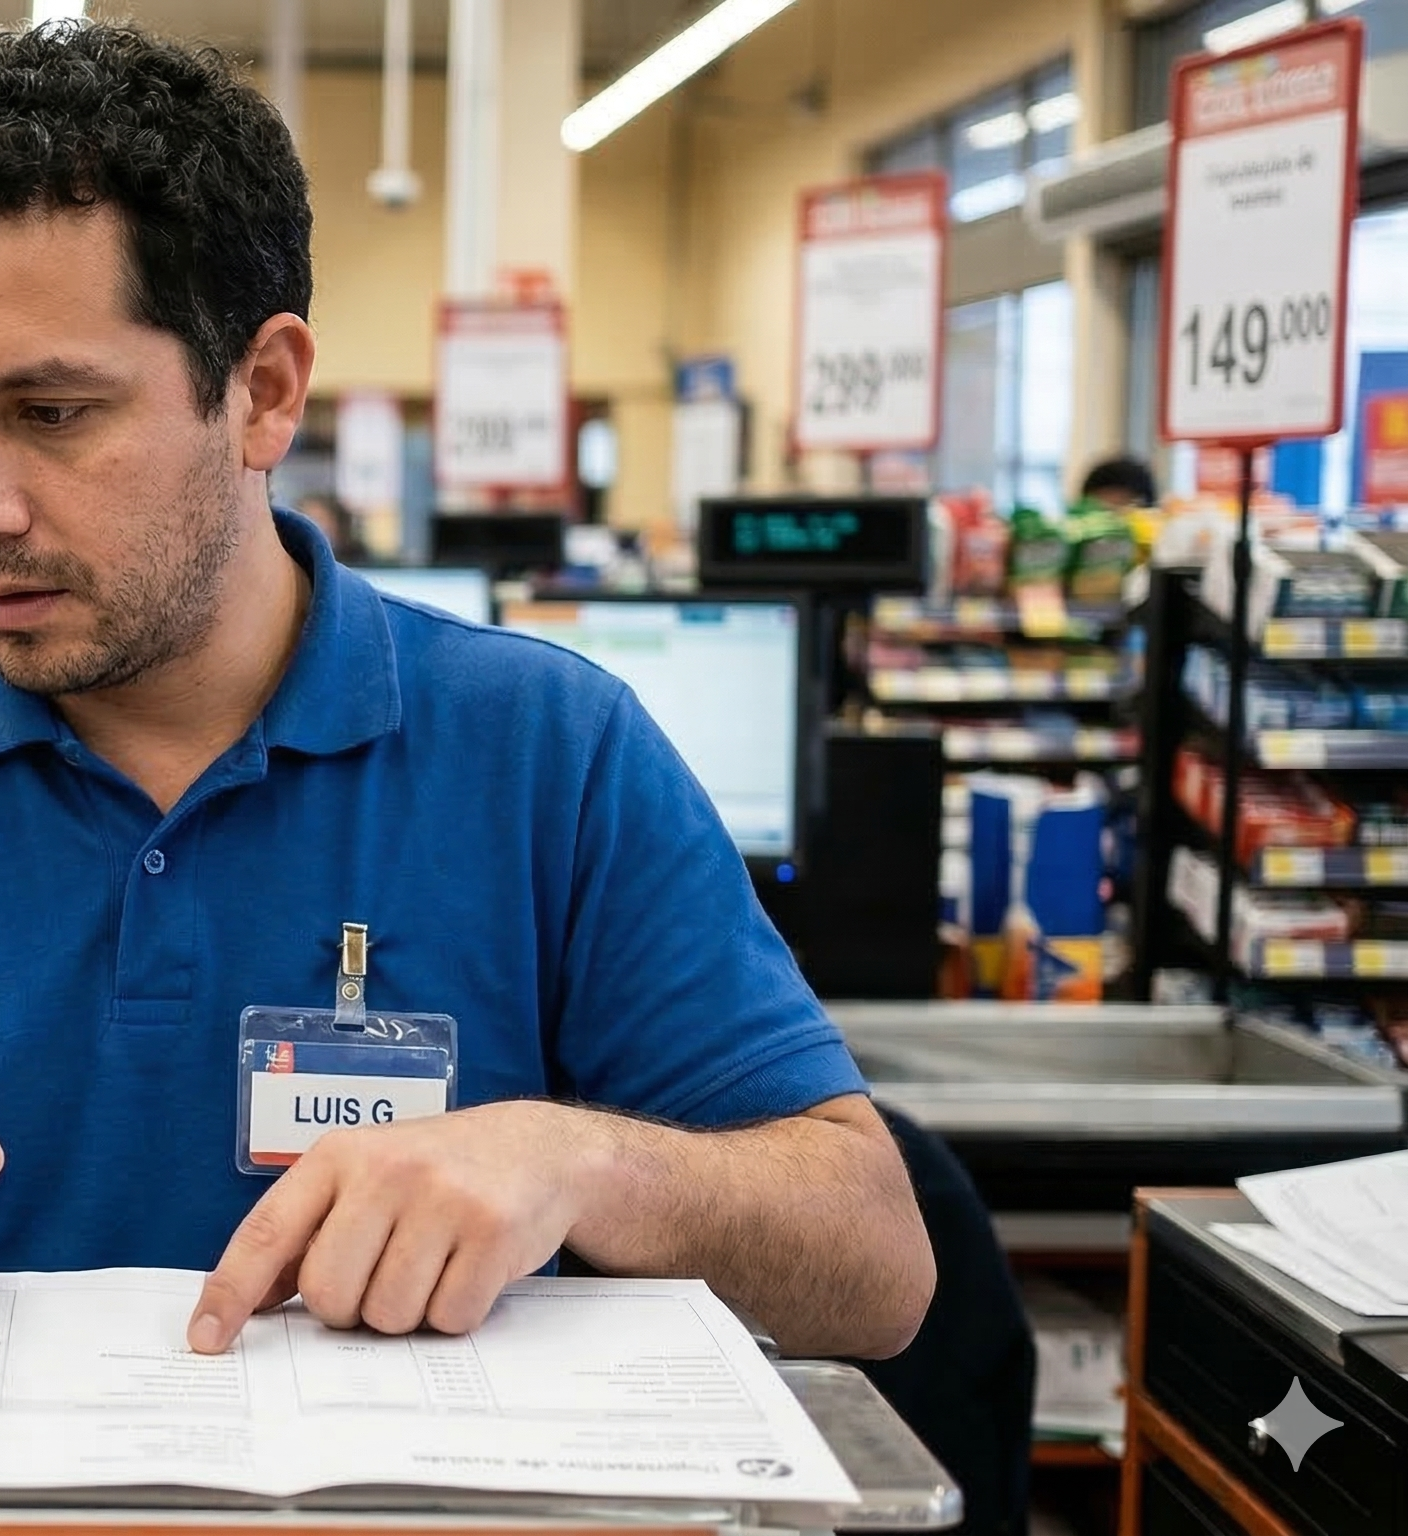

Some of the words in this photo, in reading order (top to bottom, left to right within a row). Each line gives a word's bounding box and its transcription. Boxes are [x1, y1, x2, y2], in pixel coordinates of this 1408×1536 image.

[1180, 293, 1330, 386] 149.000
[295, 1096, 360, 1125] LUIS
[372, 1099, 393, 1124] G
